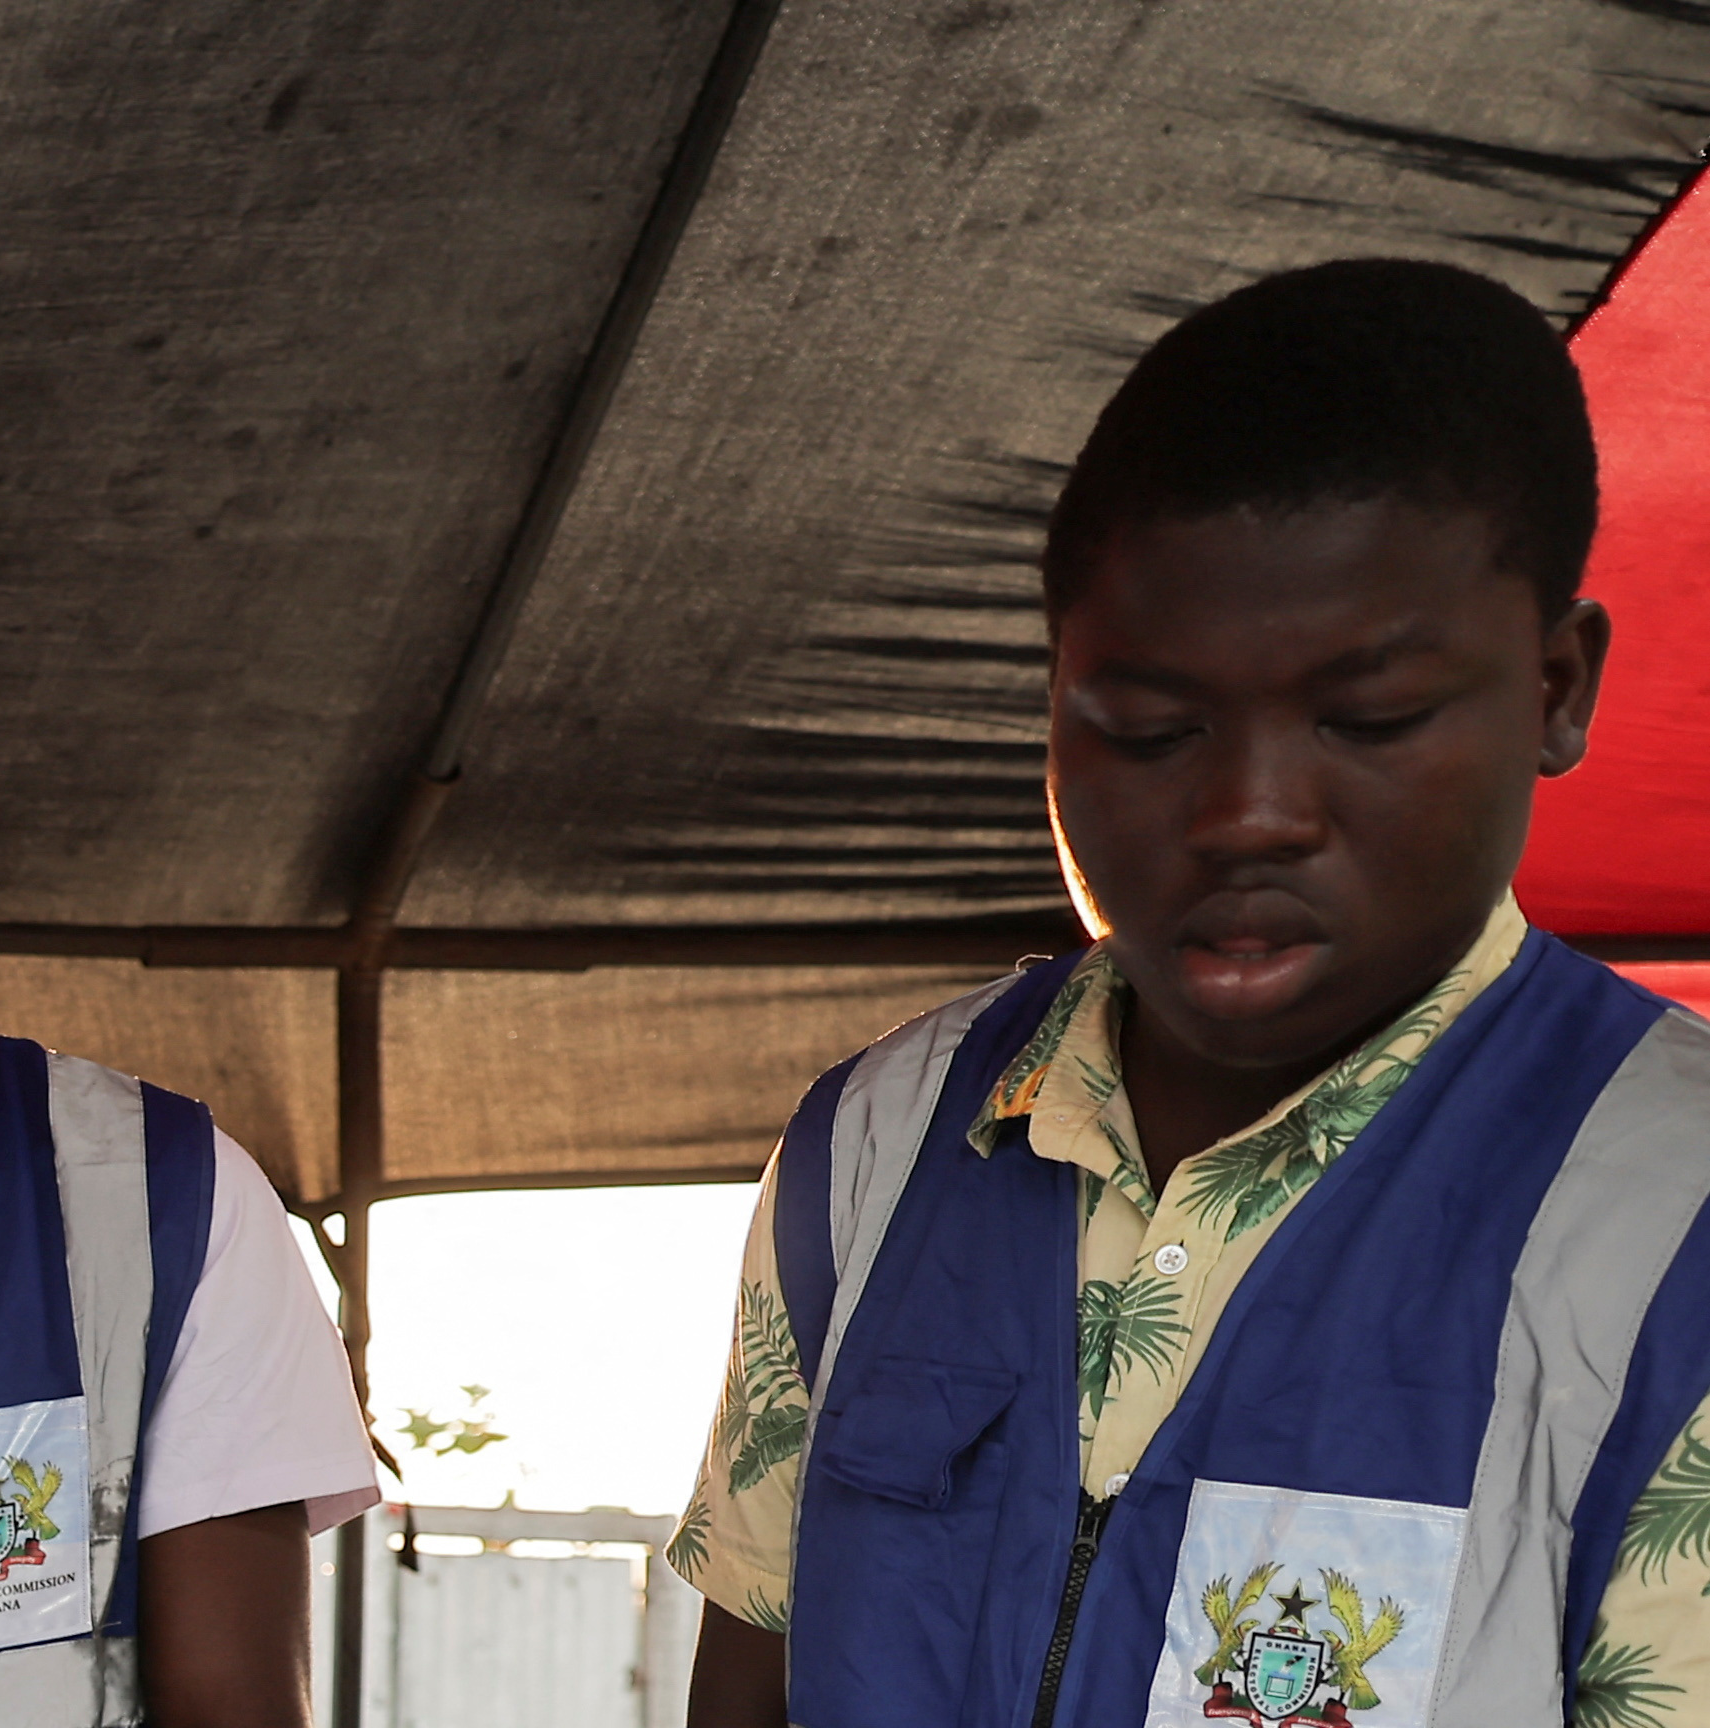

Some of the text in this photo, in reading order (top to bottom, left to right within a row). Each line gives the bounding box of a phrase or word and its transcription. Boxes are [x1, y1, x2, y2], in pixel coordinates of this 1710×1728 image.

[1266, 1641, 1307, 1653] GHANA
[1249, 1649, 1316, 1713] ELECTORAL COMMISSION
